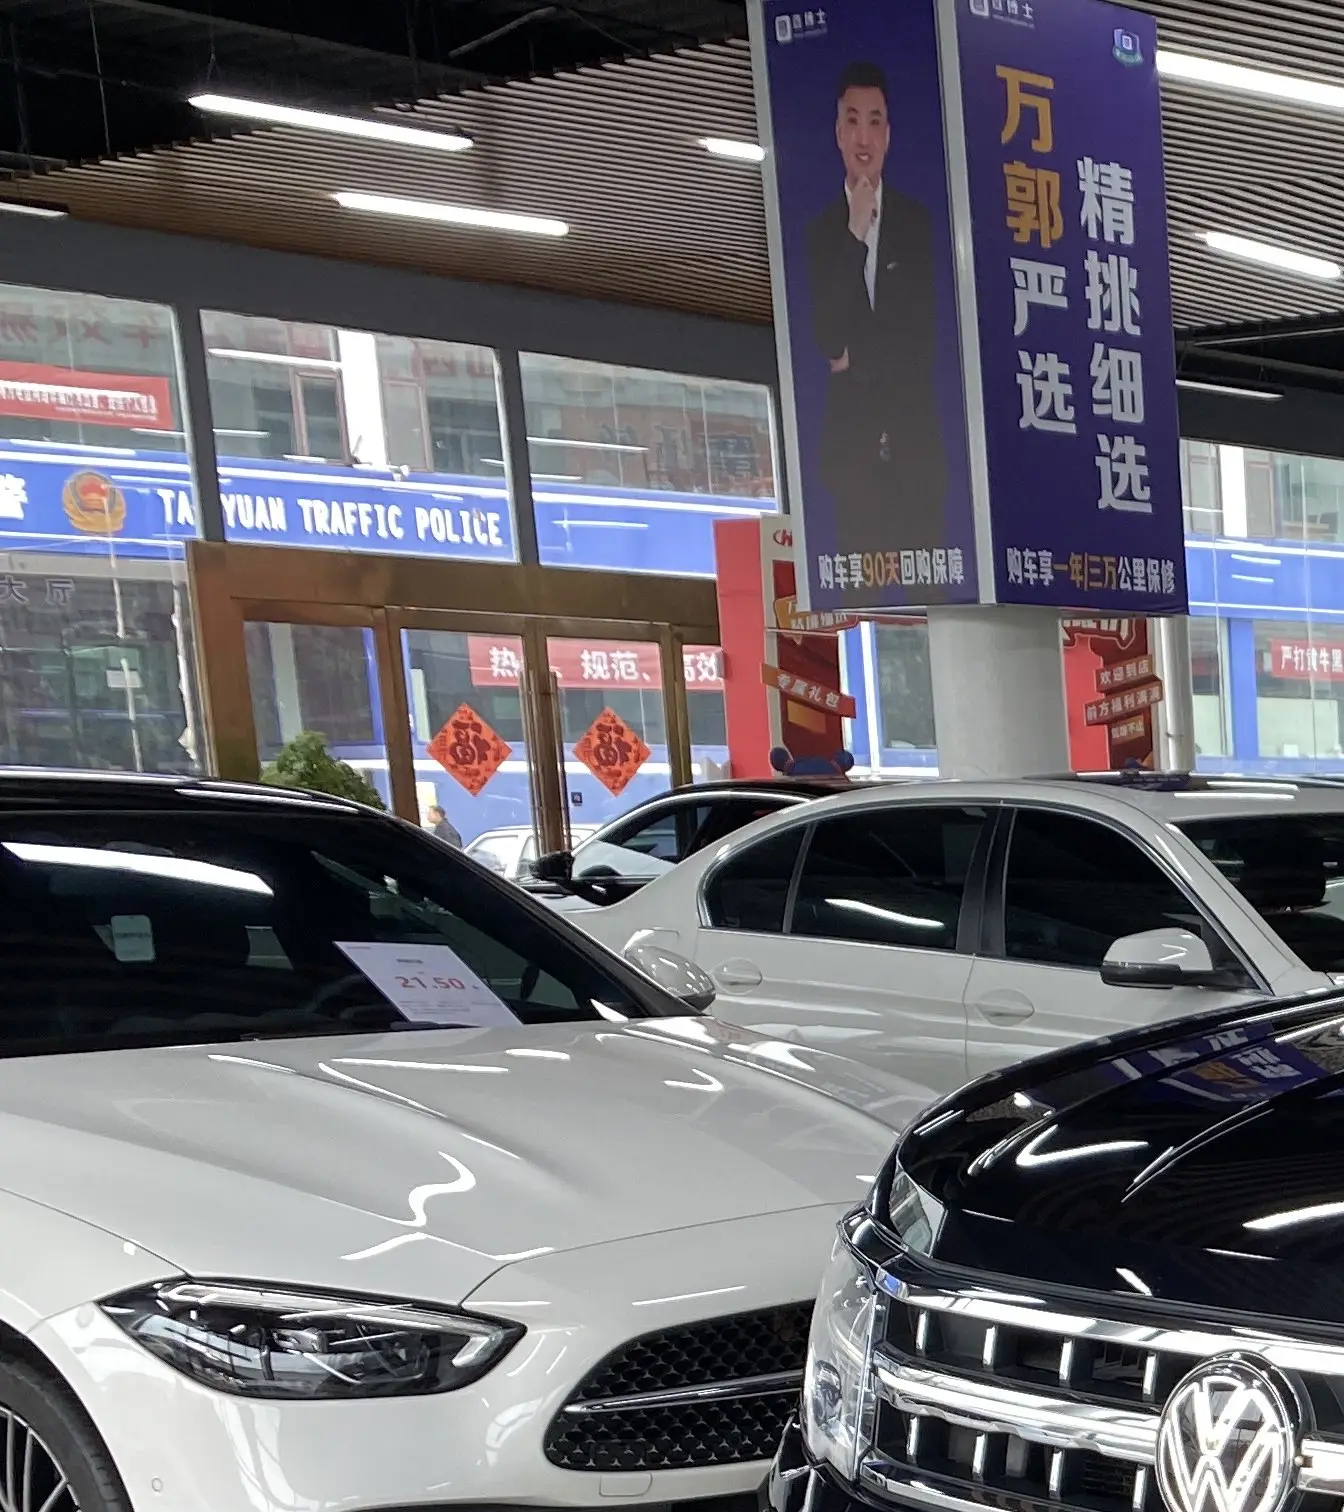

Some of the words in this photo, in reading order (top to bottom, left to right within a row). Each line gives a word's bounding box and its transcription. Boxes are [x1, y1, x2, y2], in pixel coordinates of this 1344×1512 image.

[995, 64, 1077, 434] 万郭严选
[1076, 155, 1153, 514] 精挑细选
[296, 498, 405, 540] TRAFFIC
[415, 506, 504, 546] POLICE
[818, 547, 965, 590] 购车享90天回购保障
[1100, 659, 1150, 685] 欢迎到店
[393, 975, 466, 990] 21.50
